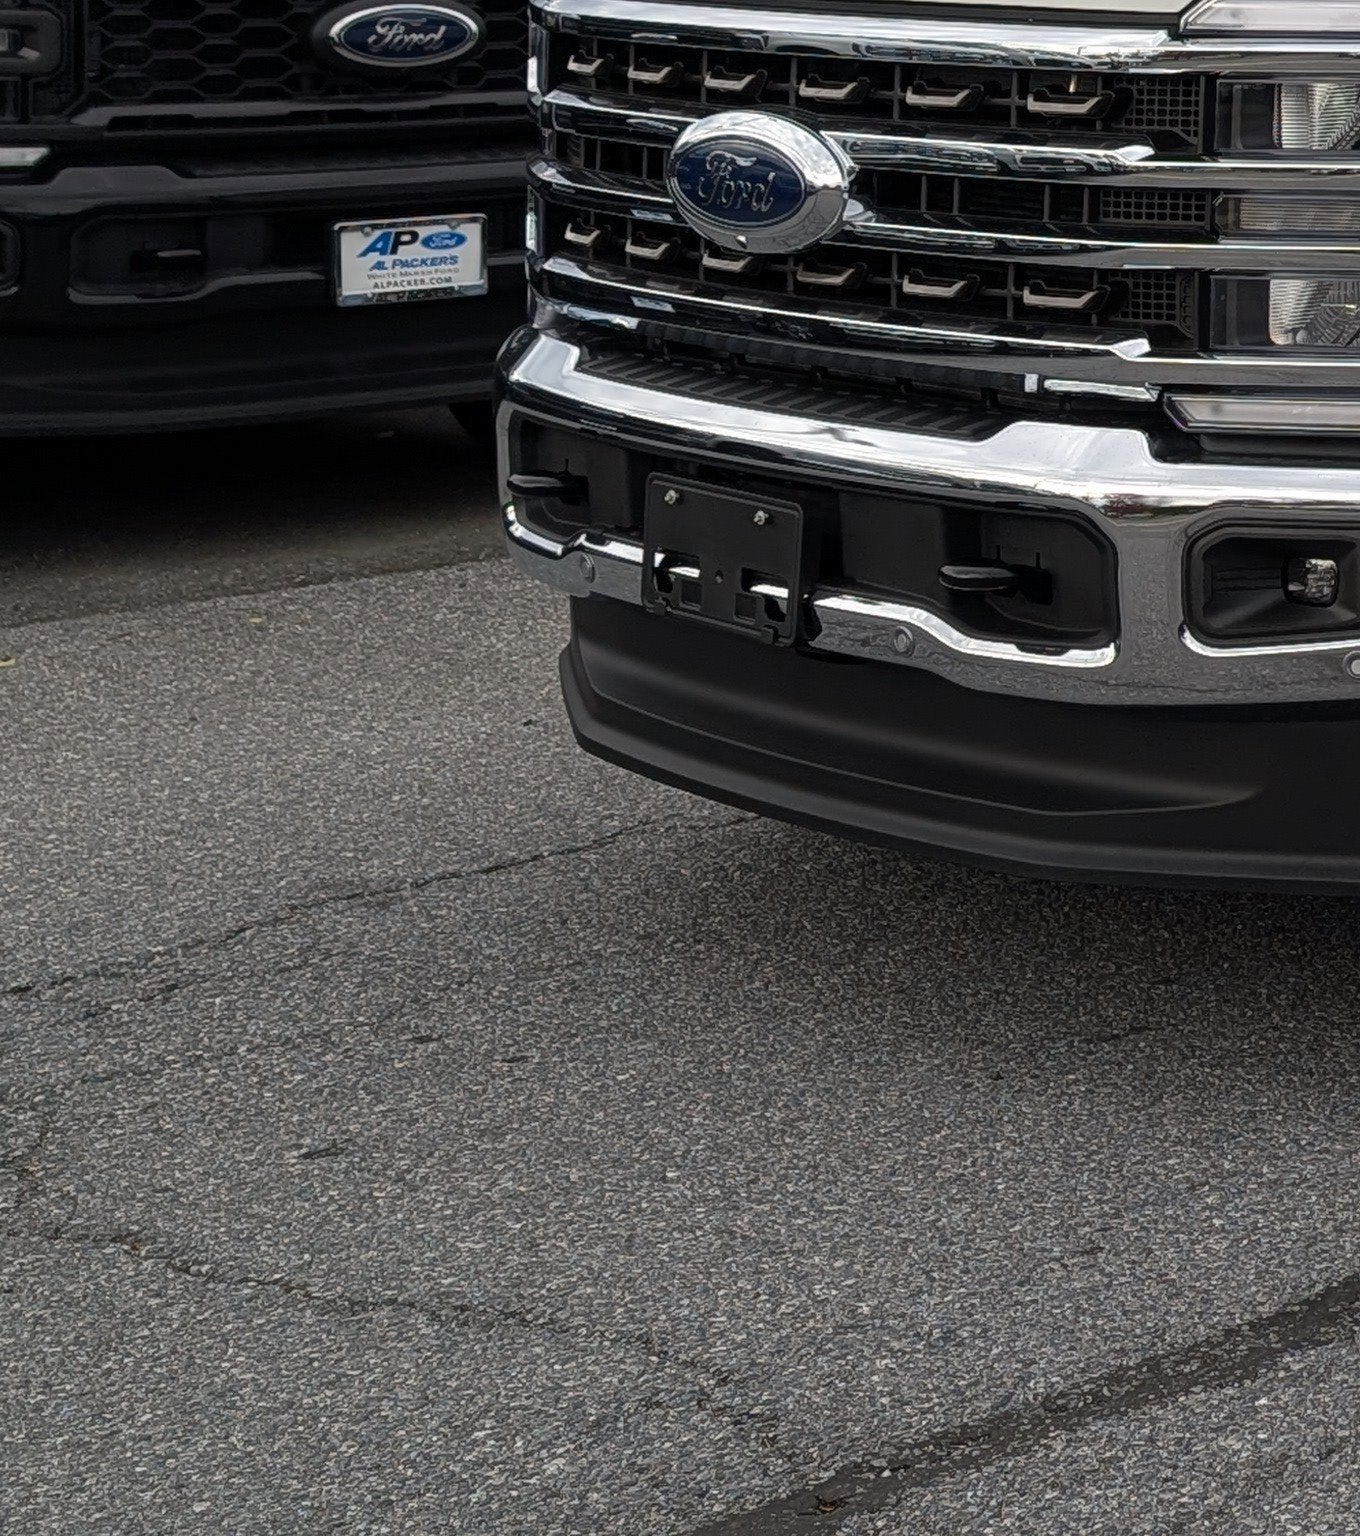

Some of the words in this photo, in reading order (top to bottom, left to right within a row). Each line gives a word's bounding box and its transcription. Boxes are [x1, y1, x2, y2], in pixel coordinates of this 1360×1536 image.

[367, 16, 447, 52] Ford
[697, 150, 776, 212] Ford
[356, 230, 420, 258] AP
[369, 260, 389, 272] AL
[372, 276, 453, 290] ALPACKER.COM
